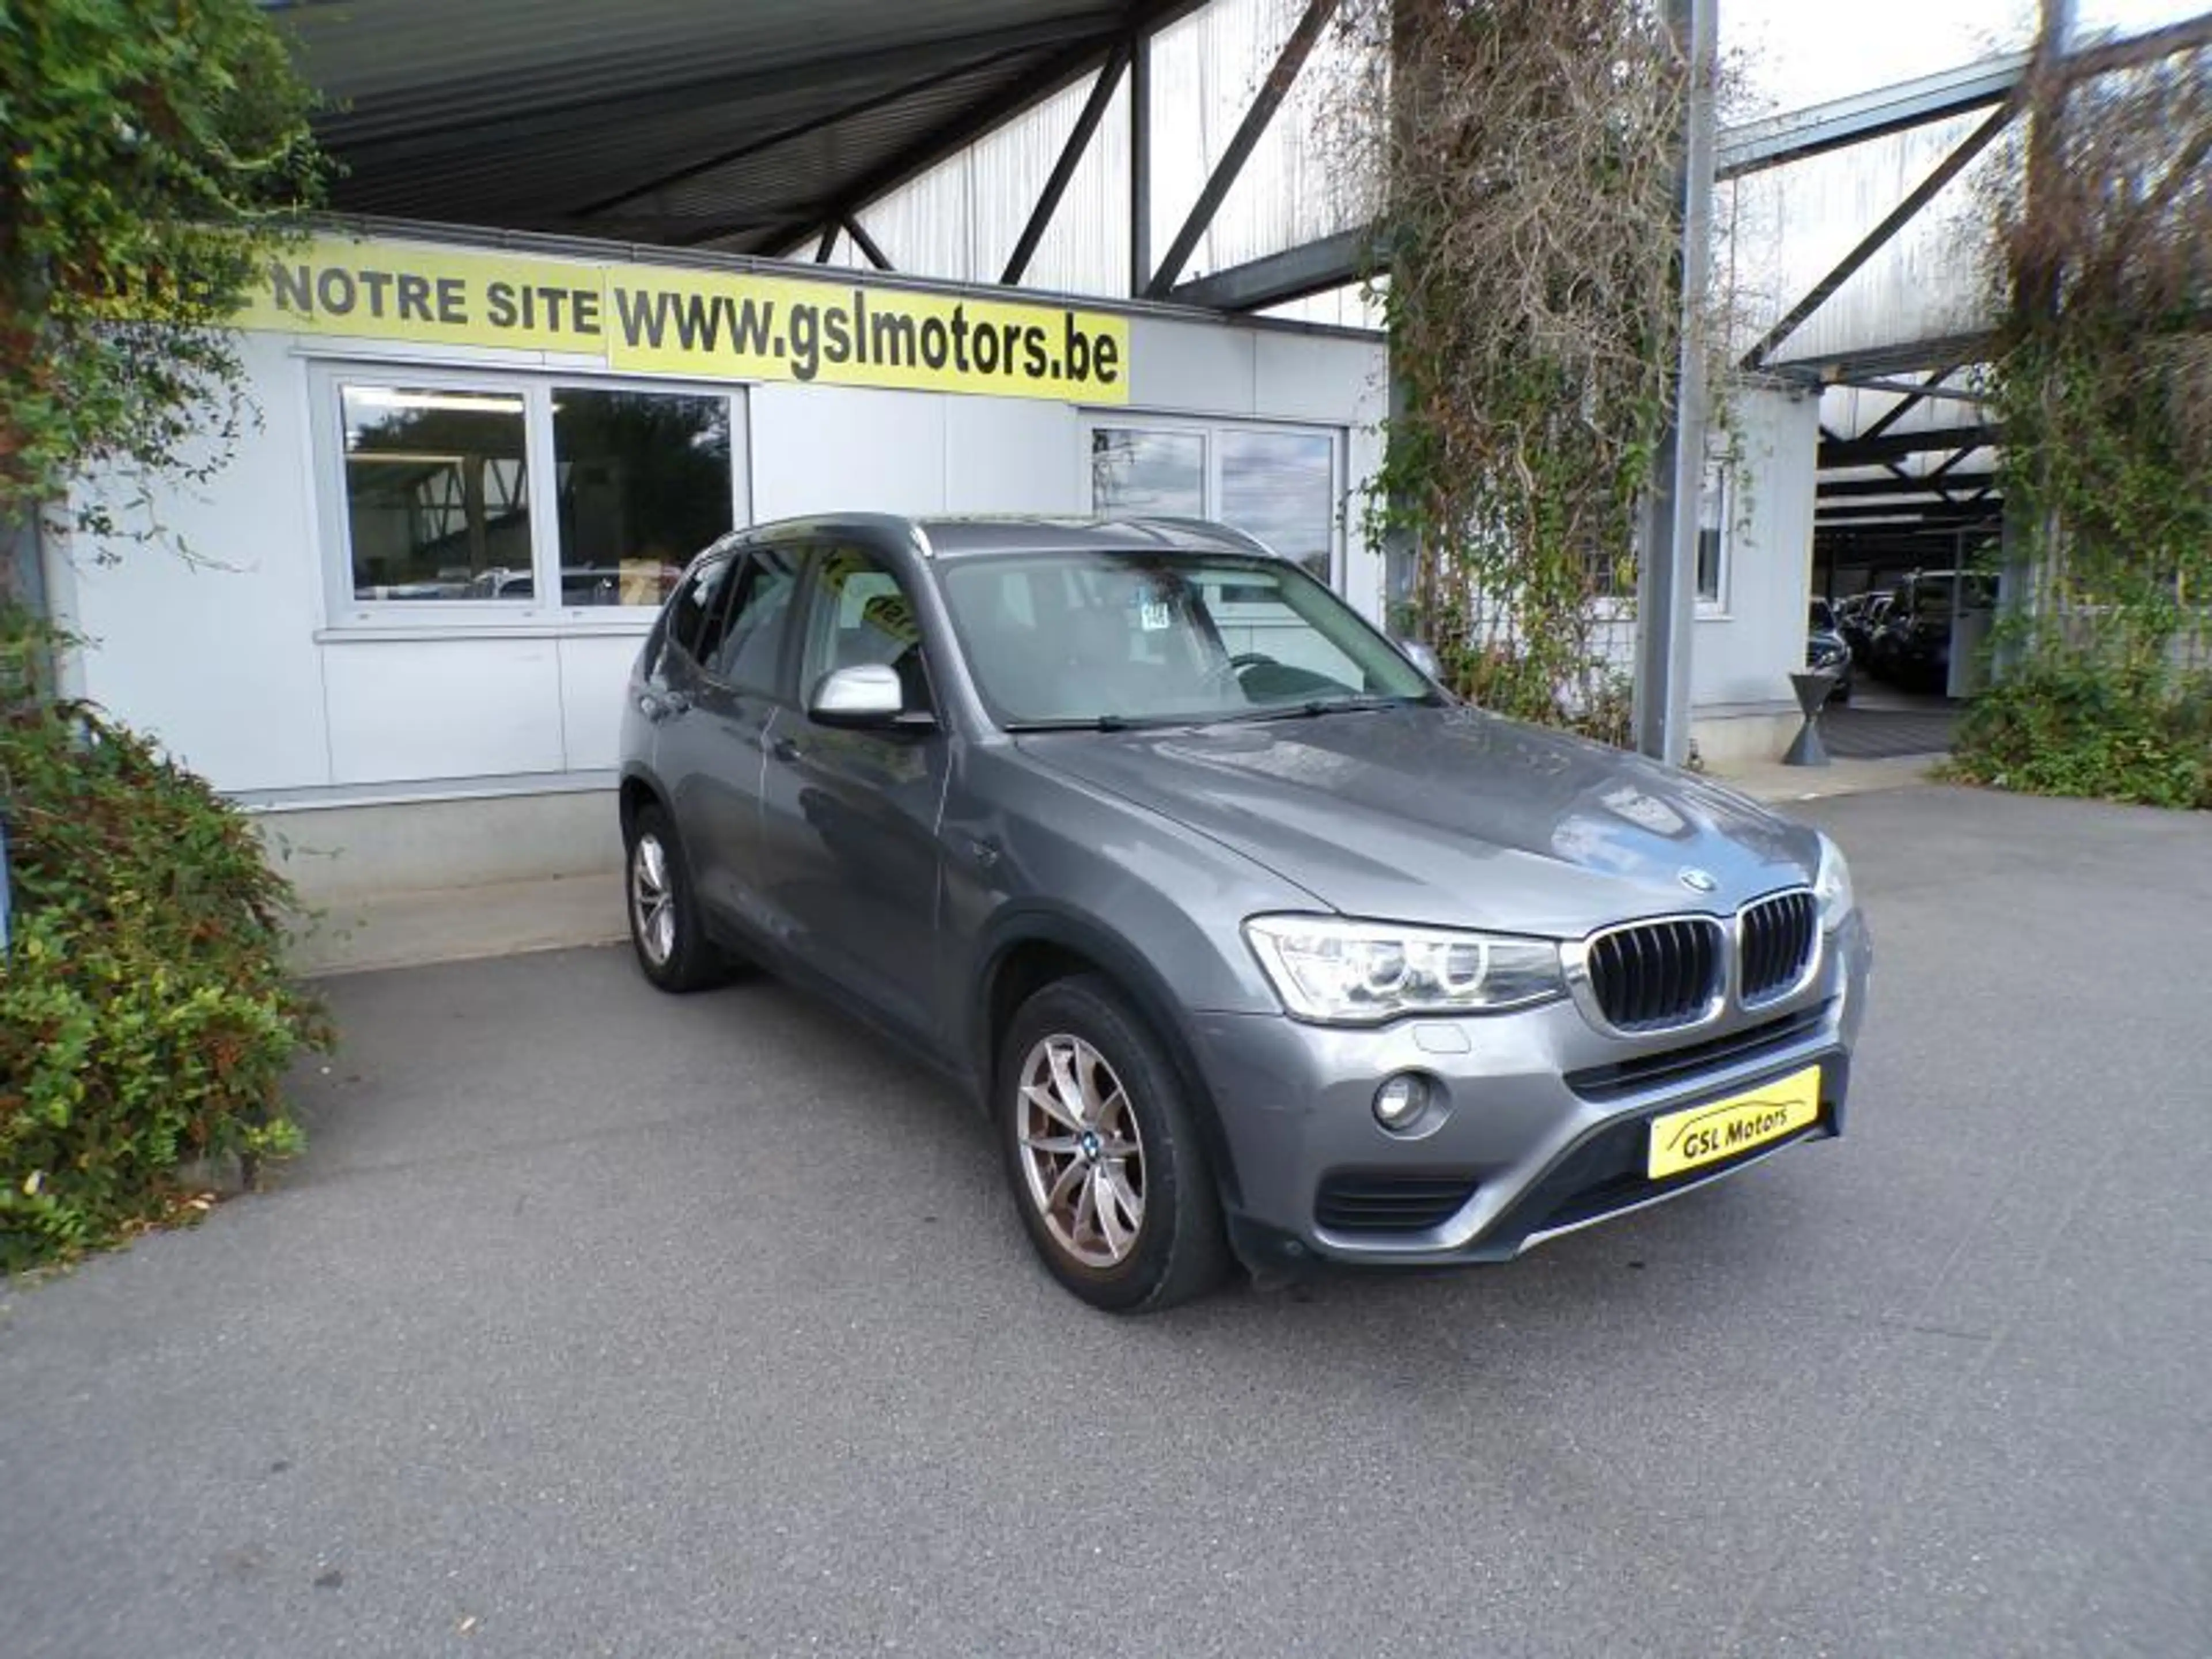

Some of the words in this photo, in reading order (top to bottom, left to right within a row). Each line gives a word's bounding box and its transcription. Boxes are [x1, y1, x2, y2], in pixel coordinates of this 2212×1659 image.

[268, 263, 469, 326] NOTRE
[487, 281, 601, 335] SITE
[614, 287, 1119, 384] www.gslmotors.be
[1683, 1128, 1719, 1160] GSL
[1725, 1108, 1788, 1147] Motors
